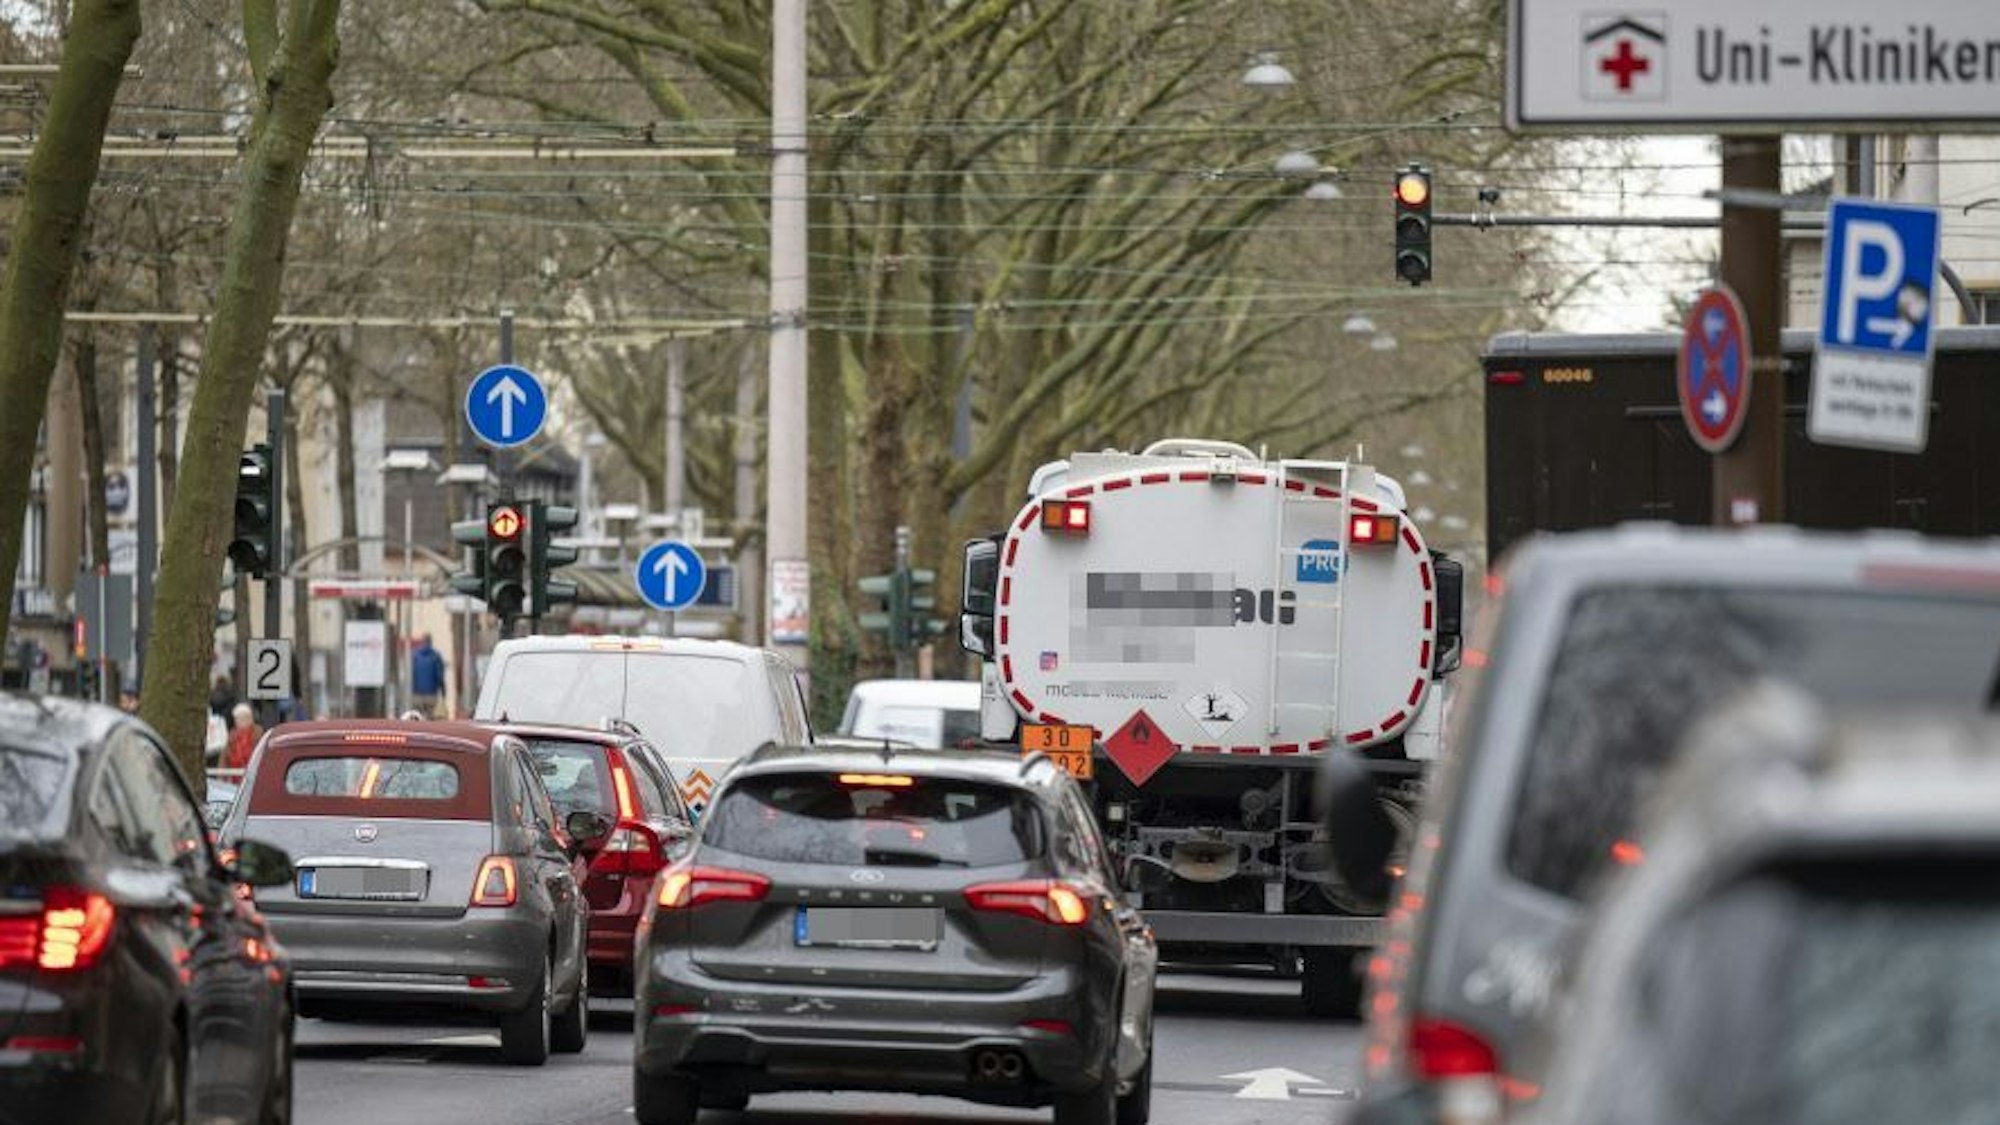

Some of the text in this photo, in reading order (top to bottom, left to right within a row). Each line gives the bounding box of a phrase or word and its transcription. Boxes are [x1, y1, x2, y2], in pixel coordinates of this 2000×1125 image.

[1837, 218, 1905, 343] P
[258, 648, 280, 690] 2
[1043, 728, 1069, 747] 30
